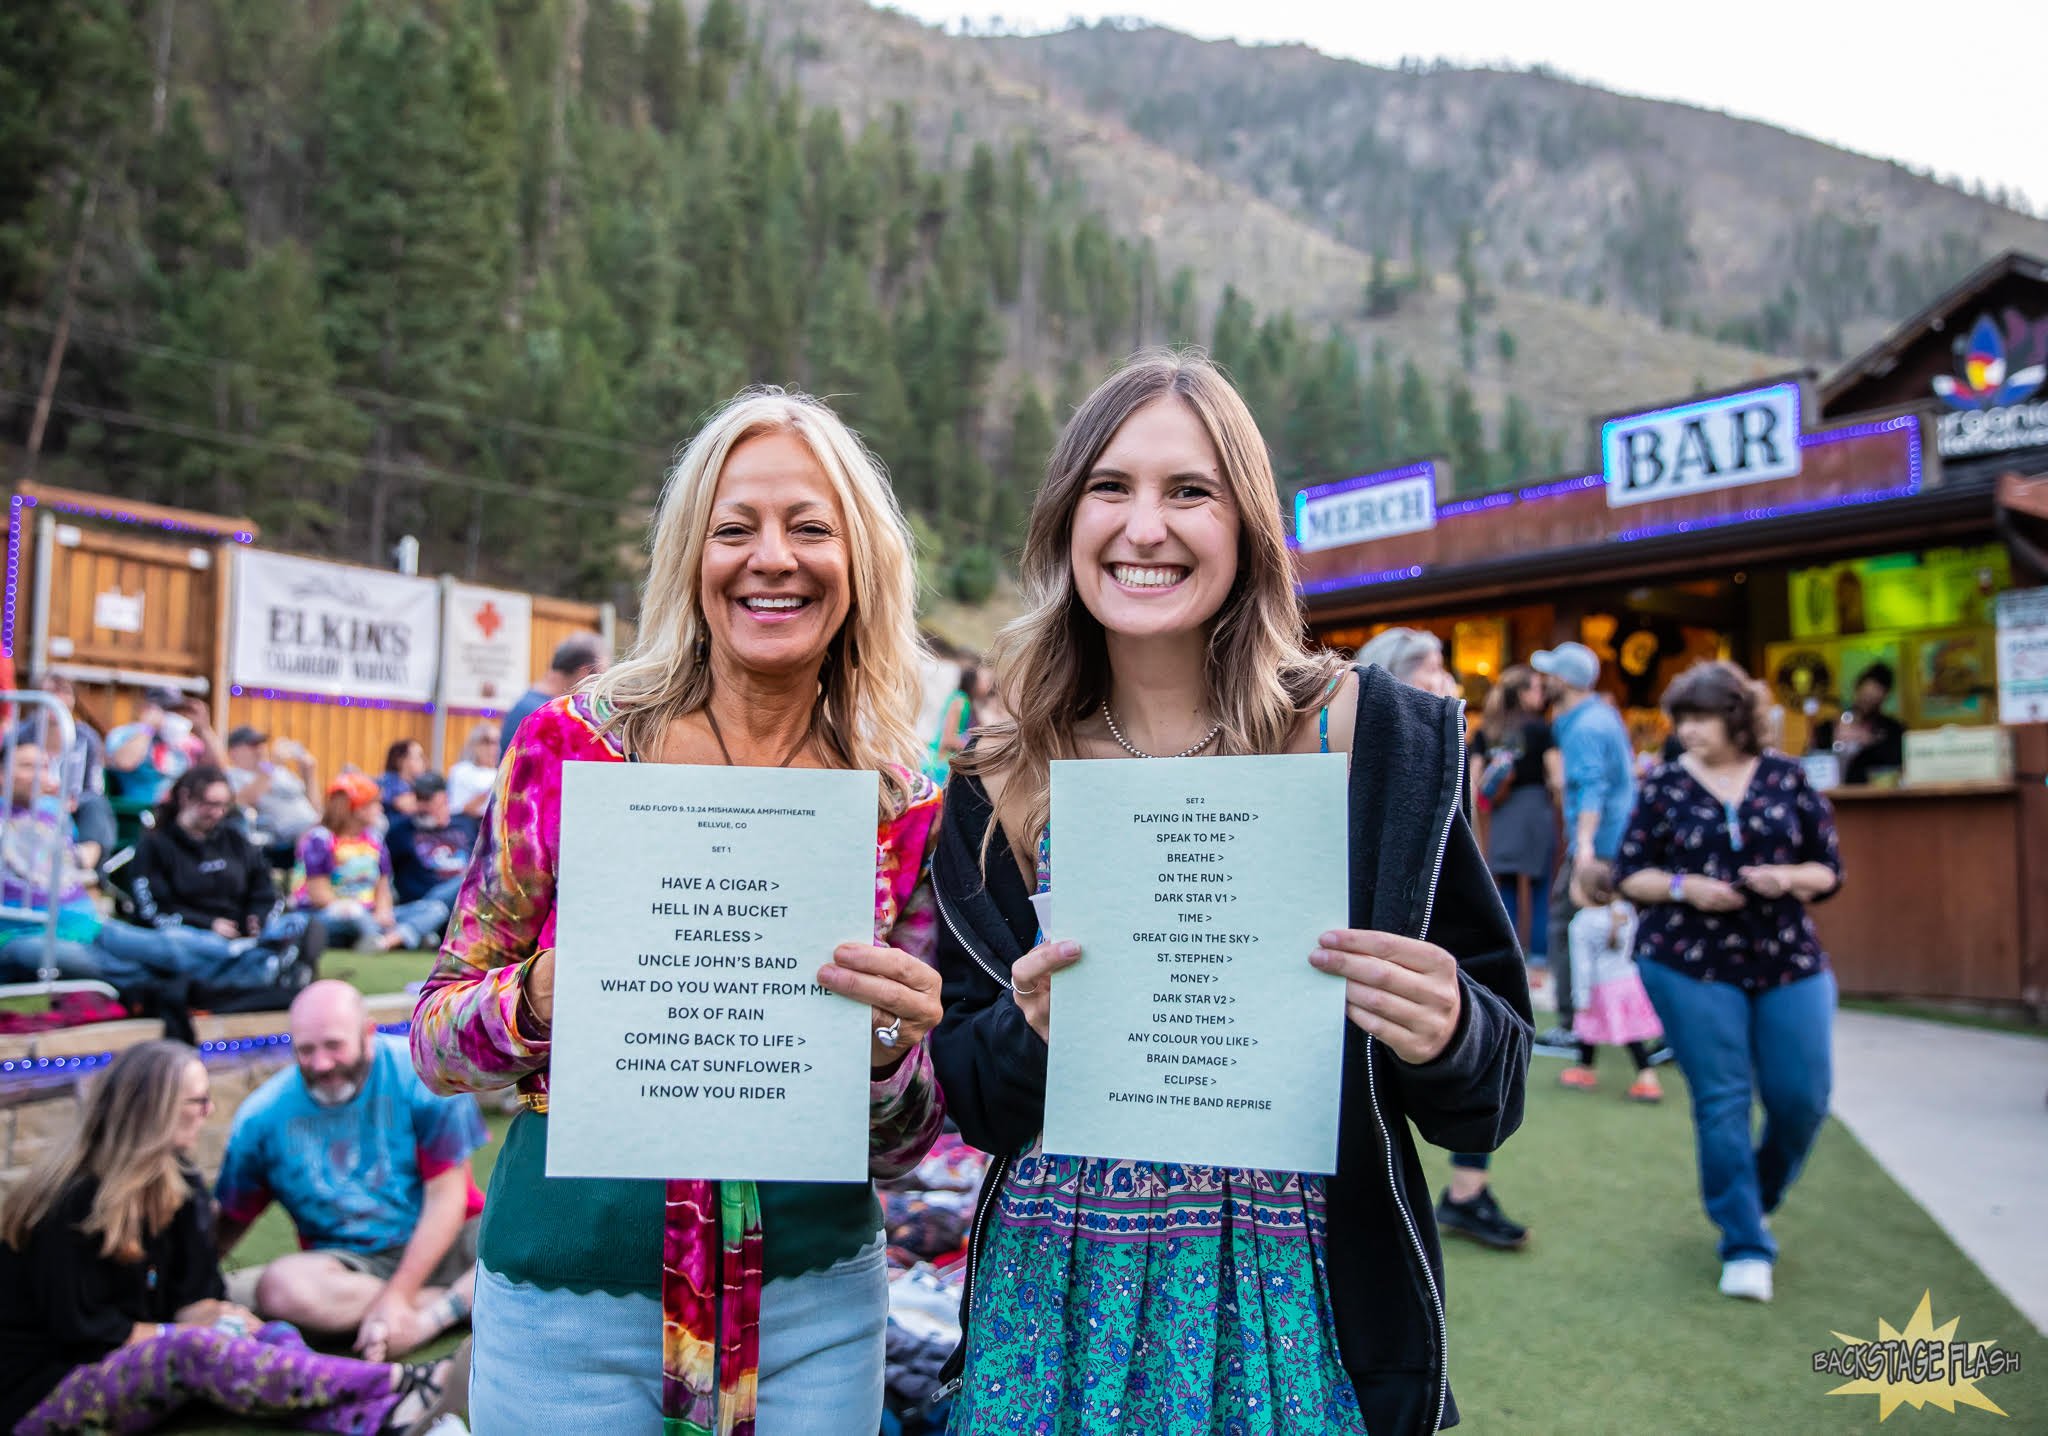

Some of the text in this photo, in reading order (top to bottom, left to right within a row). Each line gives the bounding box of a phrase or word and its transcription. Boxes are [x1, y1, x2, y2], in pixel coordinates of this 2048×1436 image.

[1620, 404, 1784, 490] BAR
[1308, 486, 1425, 536] MERCH
[1185, 797, 1205, 805] SET 2
[629, 803, 816, 817] DEAD FLOYD 9.13.24 MISHAWAKA AMPHITHEATRE
[1133, 813, 1180, 824] PLAYING
[1181, 813, 1193, 823] IN
[1195, 812, 1217, 823] THE
[1219, 812, 1250, 823] BAND
[697, 820, 748, 831] BELLVUE, CO
[1156, 833, 1191, 843] SPEAK
[1192, 832, 1209, 843] TO
[1209, 832, 1227, 843] ME
[711, 845, 731, 854] SET 1
[1167, 853, 1216, 863] BREATHE
[661, 876, 703, 891] HAVE
[704, 877, 717, 891] A
[719, 878, 768, 892] CIGAR
[1157, 873, 1175, 883] ON
[1176, 873, 1199, 883] THE
[1200, 873, 1225, 883] RUN
[1154, 892, 1184, 903] DARK
[1185, 893, 1213, 903] STAR
[1214, 893, 1227, 903] V1
[651, 902, 789, 918] HELL IN A BUCKET
[1177, 913, 1204, 923] TIME
[675, 928, 751, 943] FEARLESS
[1132, 932, 1168, 943] GREAT
[1168, 933, 1189, 943] GIG
[1191, 933, 1203, 943] IN
[1204, 933, 1227, 944] THE
[1228, 933, 1251, 944] SKY
[637, 953, 691, 968] UNCLE
[754, 956, 798, 970] BAND
[1156, 952, 1172, 963] ST.
[1174, 953, 1225, 964] STEPHEN
[1170, 973, 1211, 984] MONEY
[600, 979, 647, 993] WHAT
[649, 980, 673, 993] DO
[676, 980, 710, 994] YOU
[712, 981, 760, 995] WANT
[762, 982, 807, 996] FROM
[1152, 993, 1183, 1003] DARK
[1184, 993, 1211, 1005] STAR
[1212, 994, 1227, 1005] V2
[667, 1006, 765, 1021] BOX OF RAIN
[1152, 1013, 1167, 1023] US
[1168, 1013, 1193, 1024] AND
[1194, 1014, 1226, 1025] THEM
[623, 1031, 691, 1046] COMING
[693, 1033, 736, 1047] BACK
[738, 1033, 759, 1047] TO
[762, 1034, 795, 1048] LIFE
[1127, 1032, 1151, 1043] ANY
[1151, 1033, 1198, 1045] COLOUR
[1200, 1035, 1224, 1046] YOU
[1225, 1035, 1250, 1047] LIKE
[615, 1057, 667, 1072] CHINA
[669, 1059, 701, 1073] CAT
[703, 1059, 801, 1074] SUNFLOWER
[1146, 1053, 1180, 1065] BRAIN
[1181, 1054, 1229, 1067] DAMAGE
[1163, 1074, 1209, 1087] ECLIPSE
[641, 1084, 786, 1101] I KNOW YOU RIDER
[1108, 1091, 1273, 1111] PLAYING IN THE BAND REPRISE
